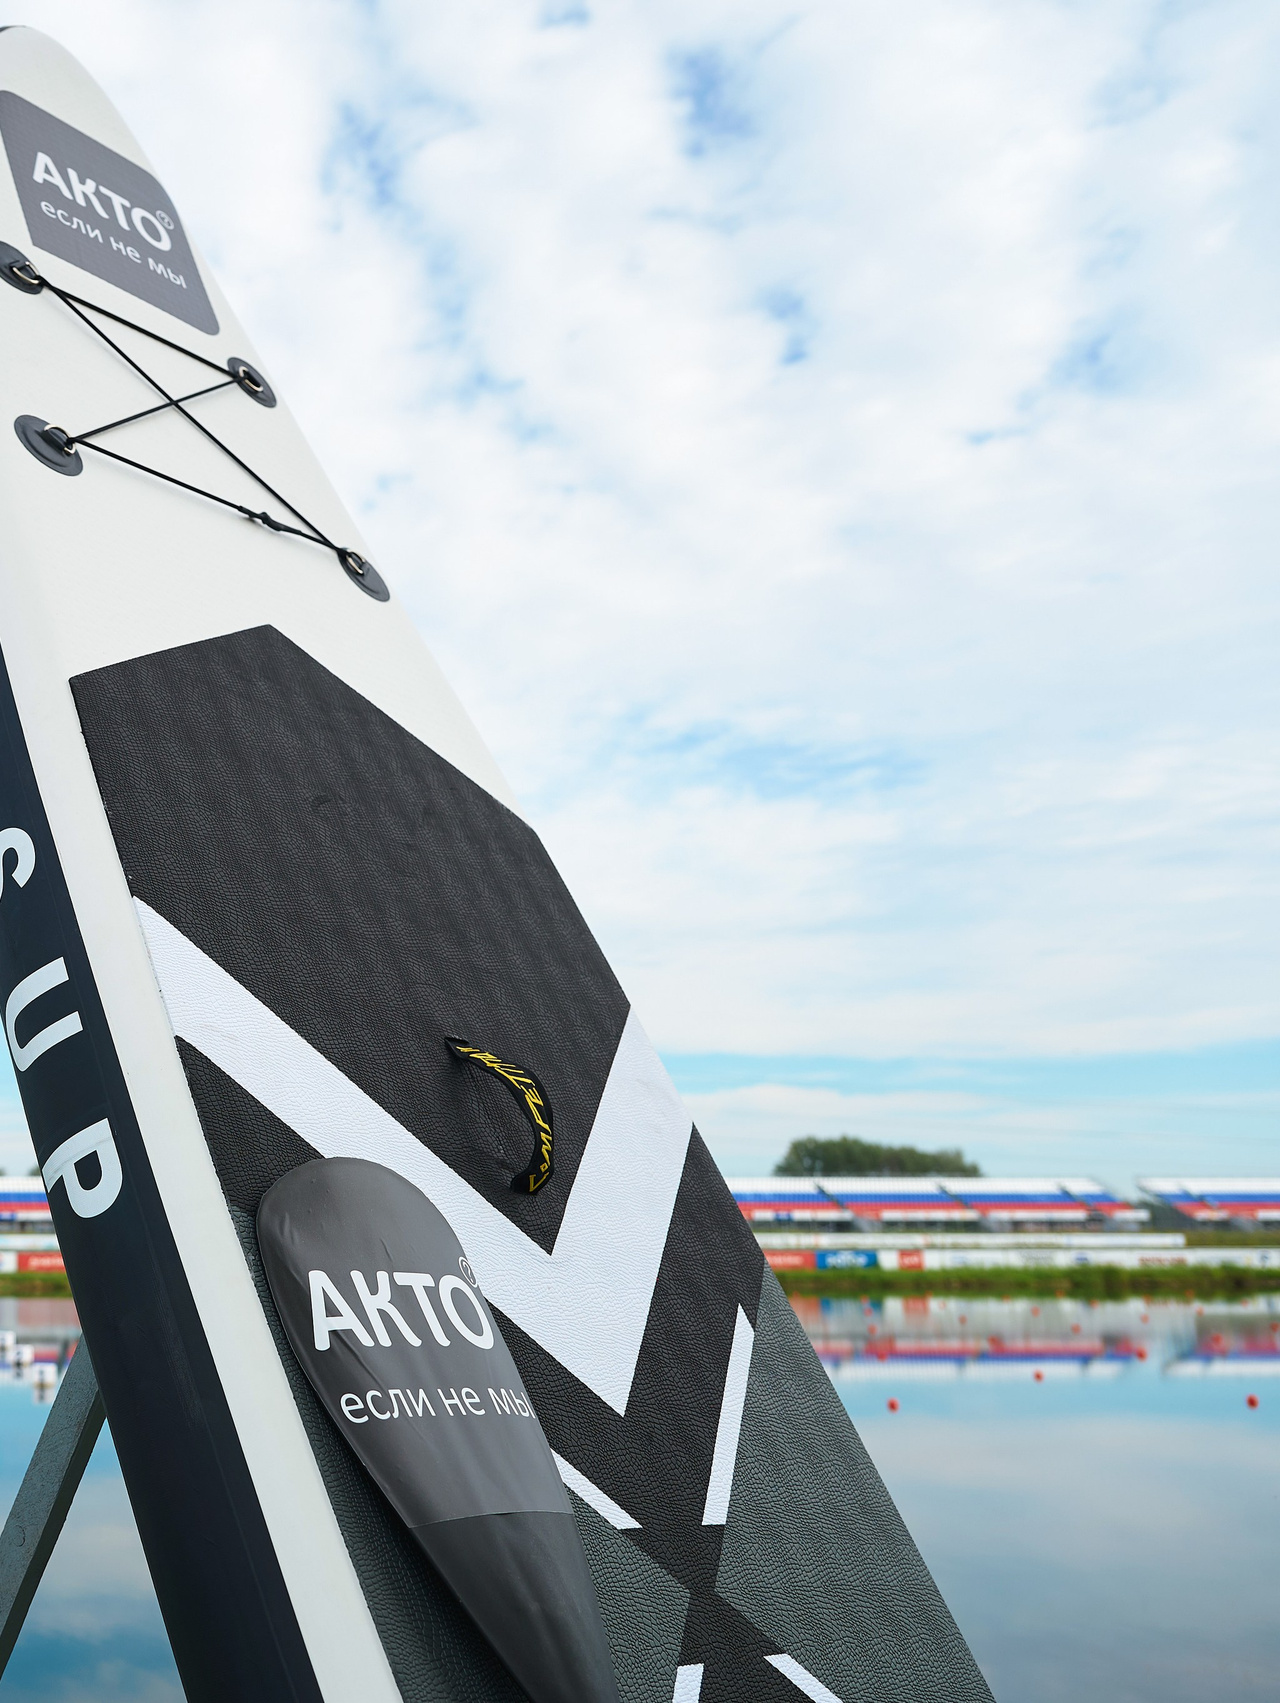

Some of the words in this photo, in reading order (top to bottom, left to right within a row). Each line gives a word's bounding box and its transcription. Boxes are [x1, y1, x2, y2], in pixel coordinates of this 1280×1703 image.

[40, 201, 104, 244] если
[109, 236, 142, 264] не
[147, 257, 188, 290] мы
[340, 1388, 437, 1424] если
[442, 1387, 486, 1417] не
[489, 1387, 537, 1420] мы
